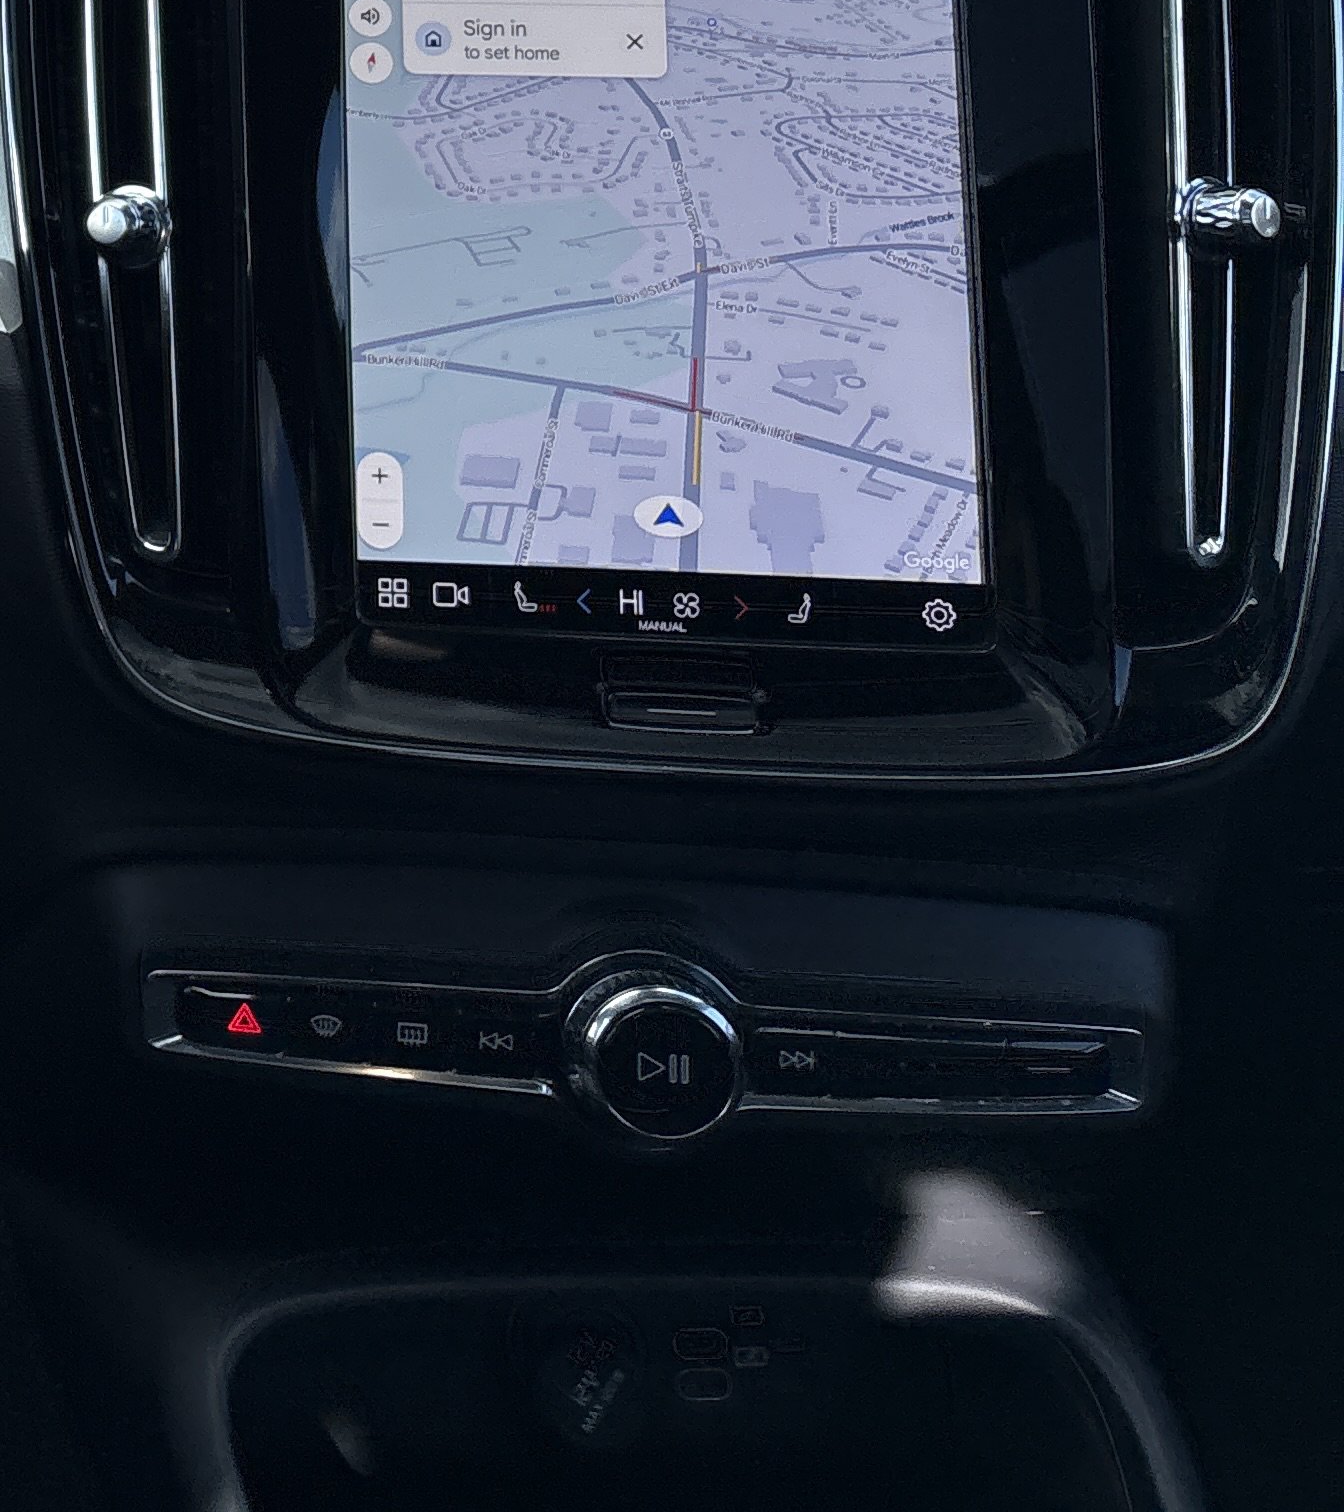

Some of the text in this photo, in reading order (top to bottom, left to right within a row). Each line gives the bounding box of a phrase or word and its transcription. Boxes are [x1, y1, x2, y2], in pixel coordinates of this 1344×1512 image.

[463, 19, 526, 40] Sign in
[464, 45, 560, 60] to set home
[712, 412, 753, 430] Bunker
[904, 551, 969, 573] Google
[619, 588, 644, 616] HI
[638, 620, 687, 633] MANUAL
